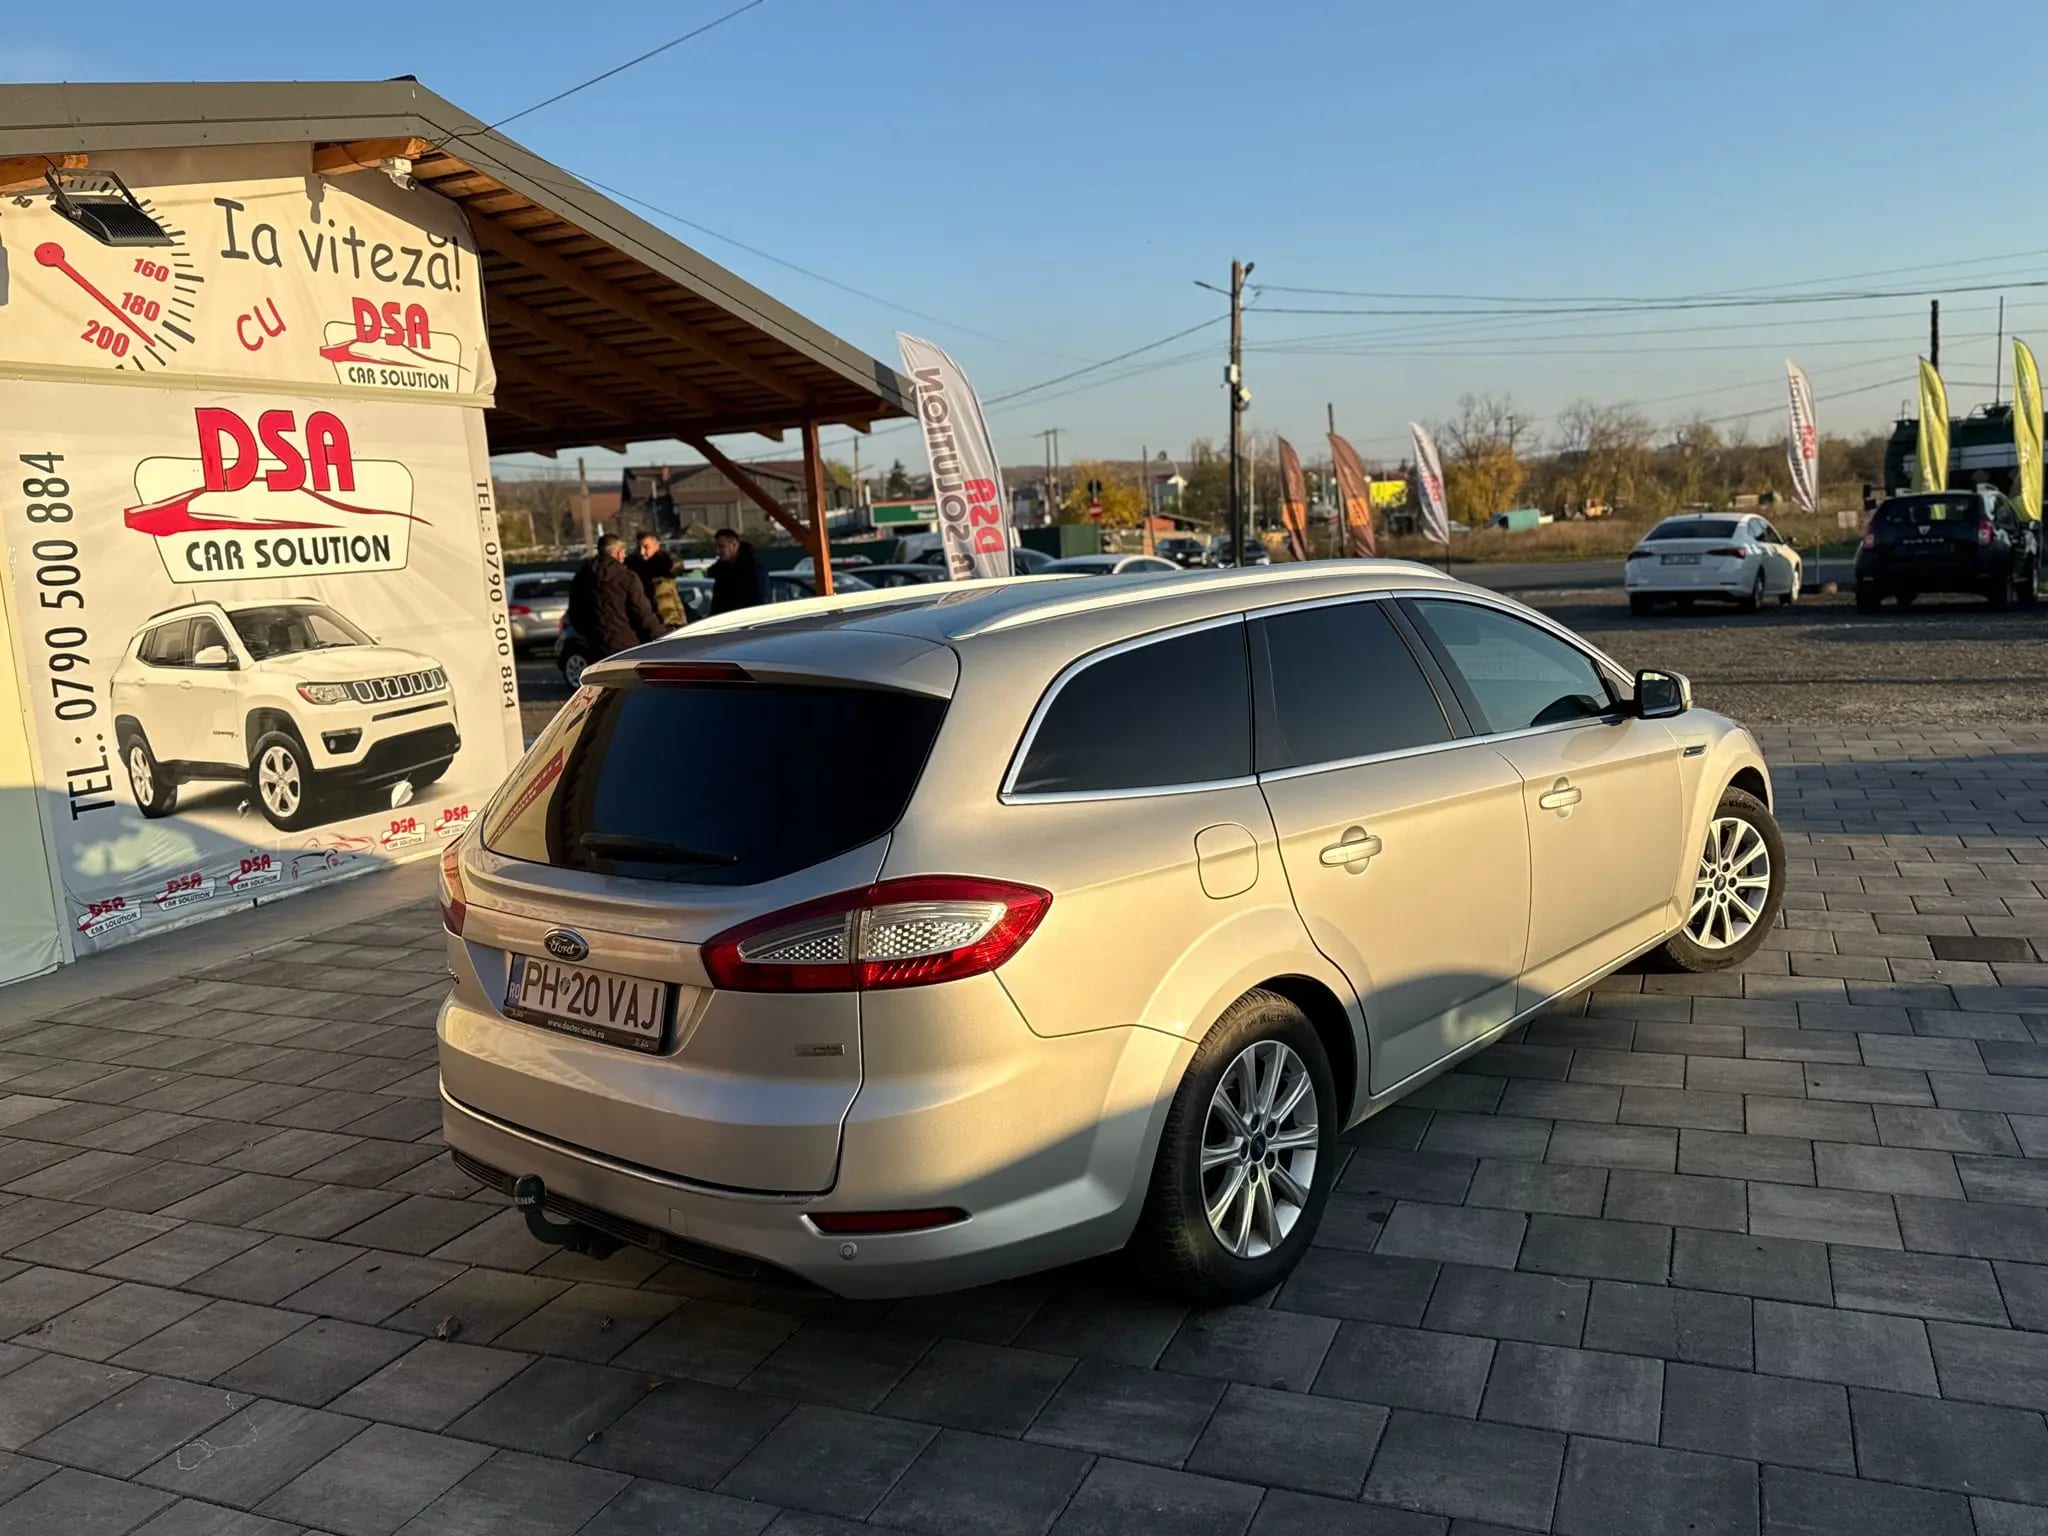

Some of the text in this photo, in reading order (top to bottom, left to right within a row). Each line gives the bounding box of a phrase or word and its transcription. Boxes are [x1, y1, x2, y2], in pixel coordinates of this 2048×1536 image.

[214, 197, 462, 293] Ia viteză!
[133, 258, 169, 282] 160
[121, 291, 160, 321] 180
[352, 297, 431, 349] DSA
[81, 320, 131, 358] 200
[348, 367, 450, 390] CAR SOLUTION
[195, 407, 355, 492] DSA
[19, 451, 74, 524] 884
[186, 534, 391, 572] CAR SOLUTION
[32, 539, 85, 609] 500
[485, 542, 503, 603] 0790
[492, 613, 510, 657] 500
[45, 626, 97, 721] 0790
[501, 665, 516, 709] 884
[391, 817, 416, 834] DSA
[443, 805, 469, 822] DSA
[240, 854, 271, 875] DSA
[167, 873, 202, 893] DSA
[236, 874, 278, 891] CAR SOLUTION
[88, 896, 126, 917] DSA
[163, 891, 211, 908] CAR SOLUTION
[91, 912, 138, 935] CAR SOLUTION
[550, 938, 575, 955] Ford
[509, 982, 521, 999] RO
[522, 961, 659, 1031] PH 20 VAJ
